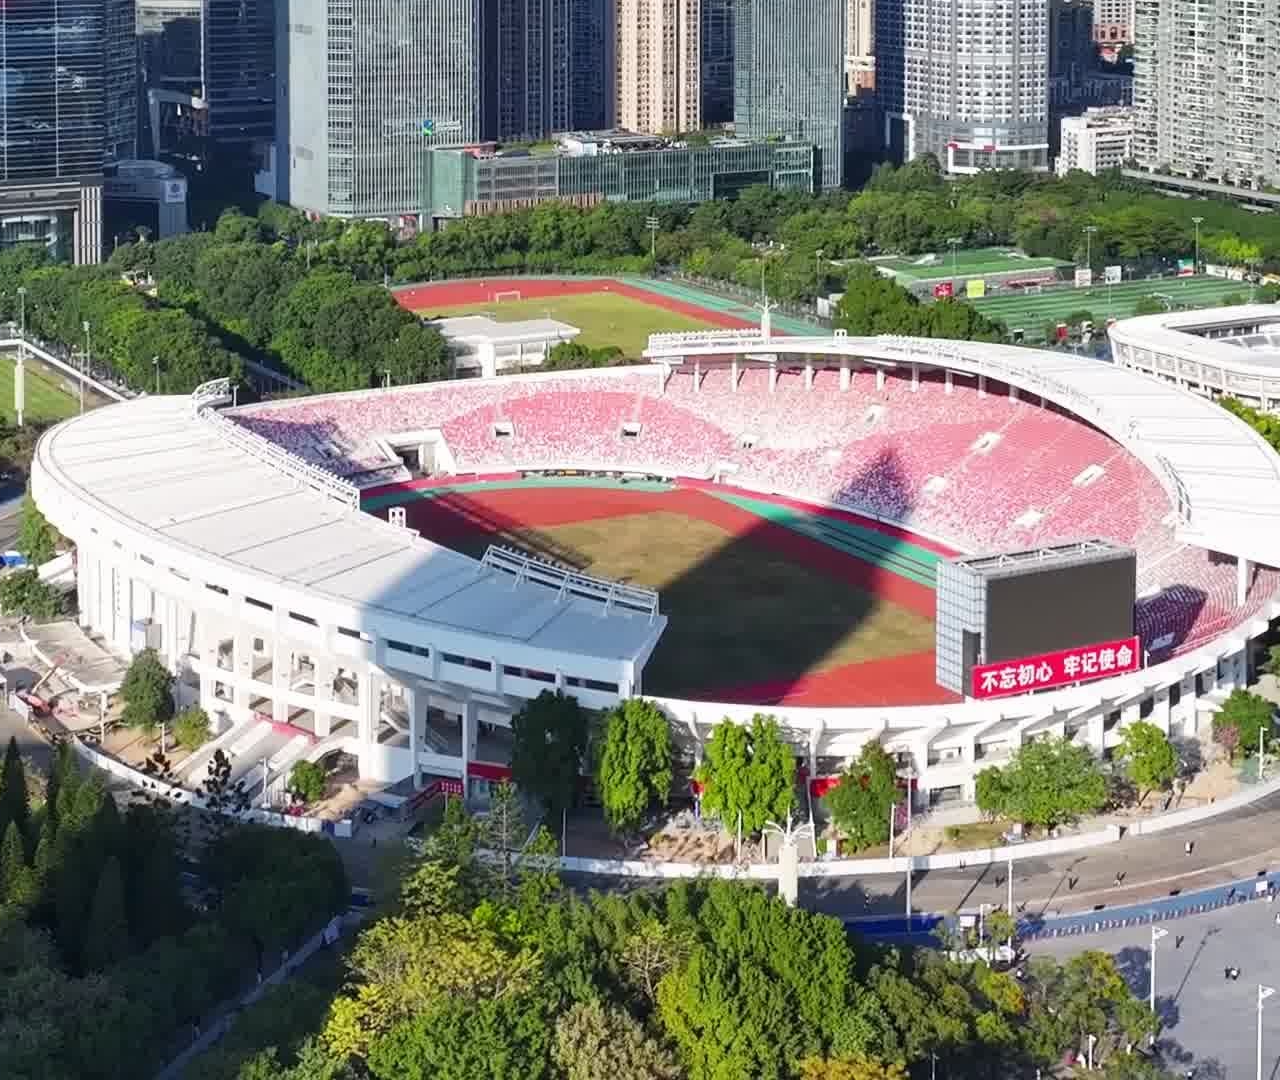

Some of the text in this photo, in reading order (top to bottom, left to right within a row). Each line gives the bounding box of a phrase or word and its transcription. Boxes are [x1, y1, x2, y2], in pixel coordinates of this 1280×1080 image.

[980, 645, 1133, 692] 不忘初心 牢记使命
